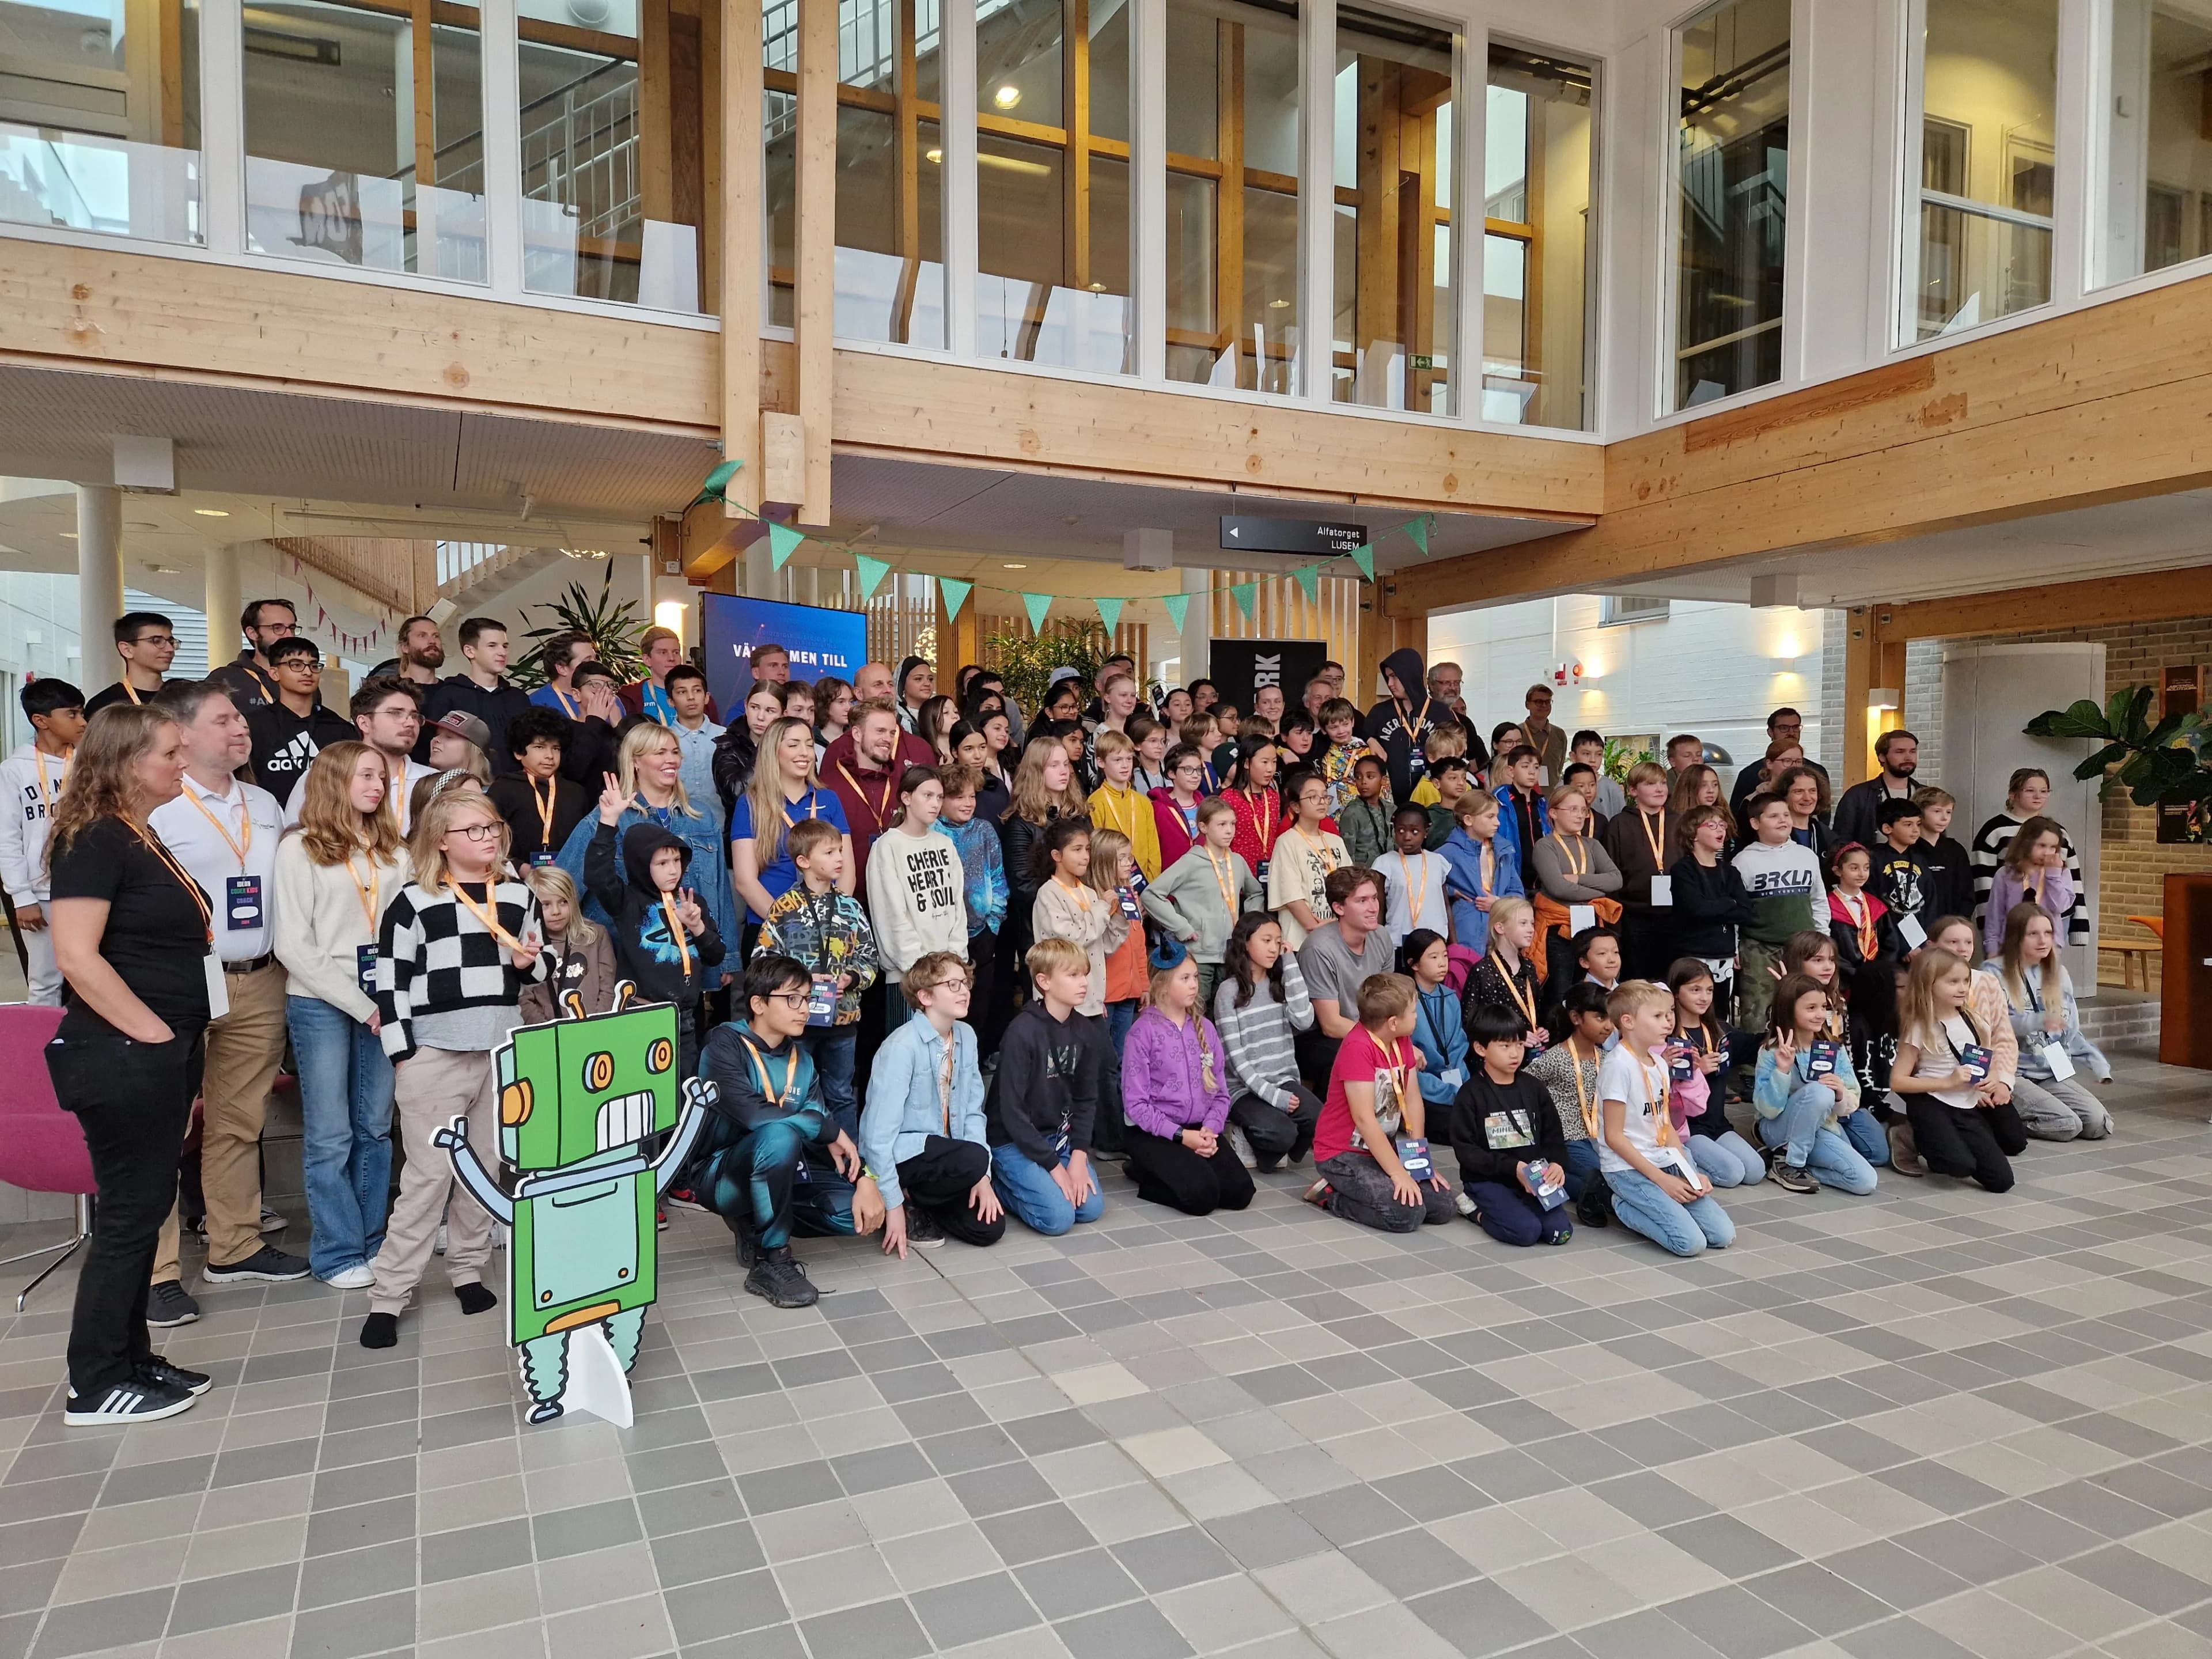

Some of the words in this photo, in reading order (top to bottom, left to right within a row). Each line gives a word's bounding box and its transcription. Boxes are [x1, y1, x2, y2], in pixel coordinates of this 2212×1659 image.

[1317, 526, 1360, 539] Alfatorget
[1331, 540, 1359, 550] LUSEM
[733, 642, 817, 666] VÄMEN
[821, 653, 848, 668] TILL
[907, 848, 949, 872] CHÉRIE
[907, 868, 945, 893] HEART
[916, 893, 927, 912] &
[930, 886, 955, 908] SOUL
